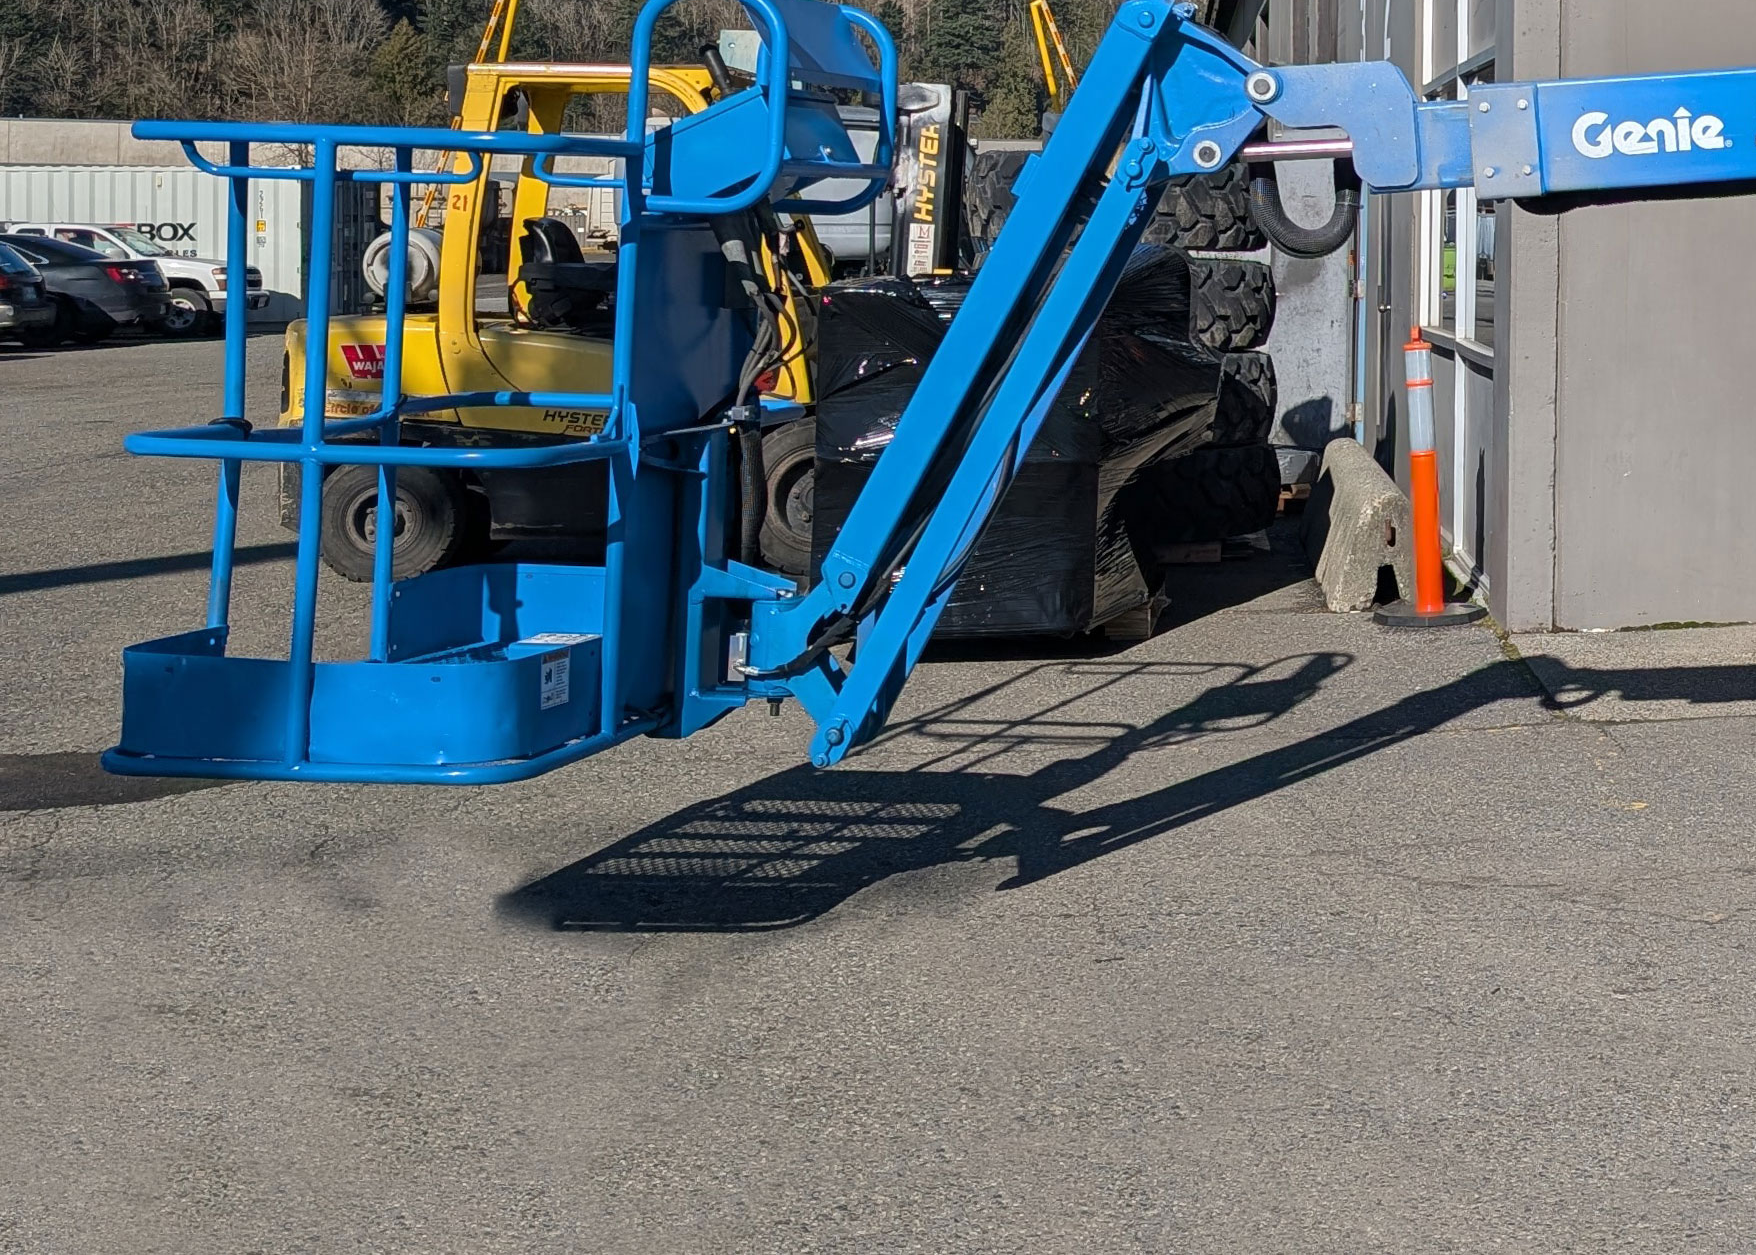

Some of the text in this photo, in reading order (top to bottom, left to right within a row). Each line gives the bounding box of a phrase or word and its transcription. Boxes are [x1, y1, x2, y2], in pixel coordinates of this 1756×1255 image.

[1572, 106, 1725, 159] Genie
[914, 124, 940, 222] HYSTER
[452, 194, 468, 212] 21
[137, 222, 197, 242] BOX
[353, 361, 385, 373] WAJA
[563, 425, 604, 434] FORT
